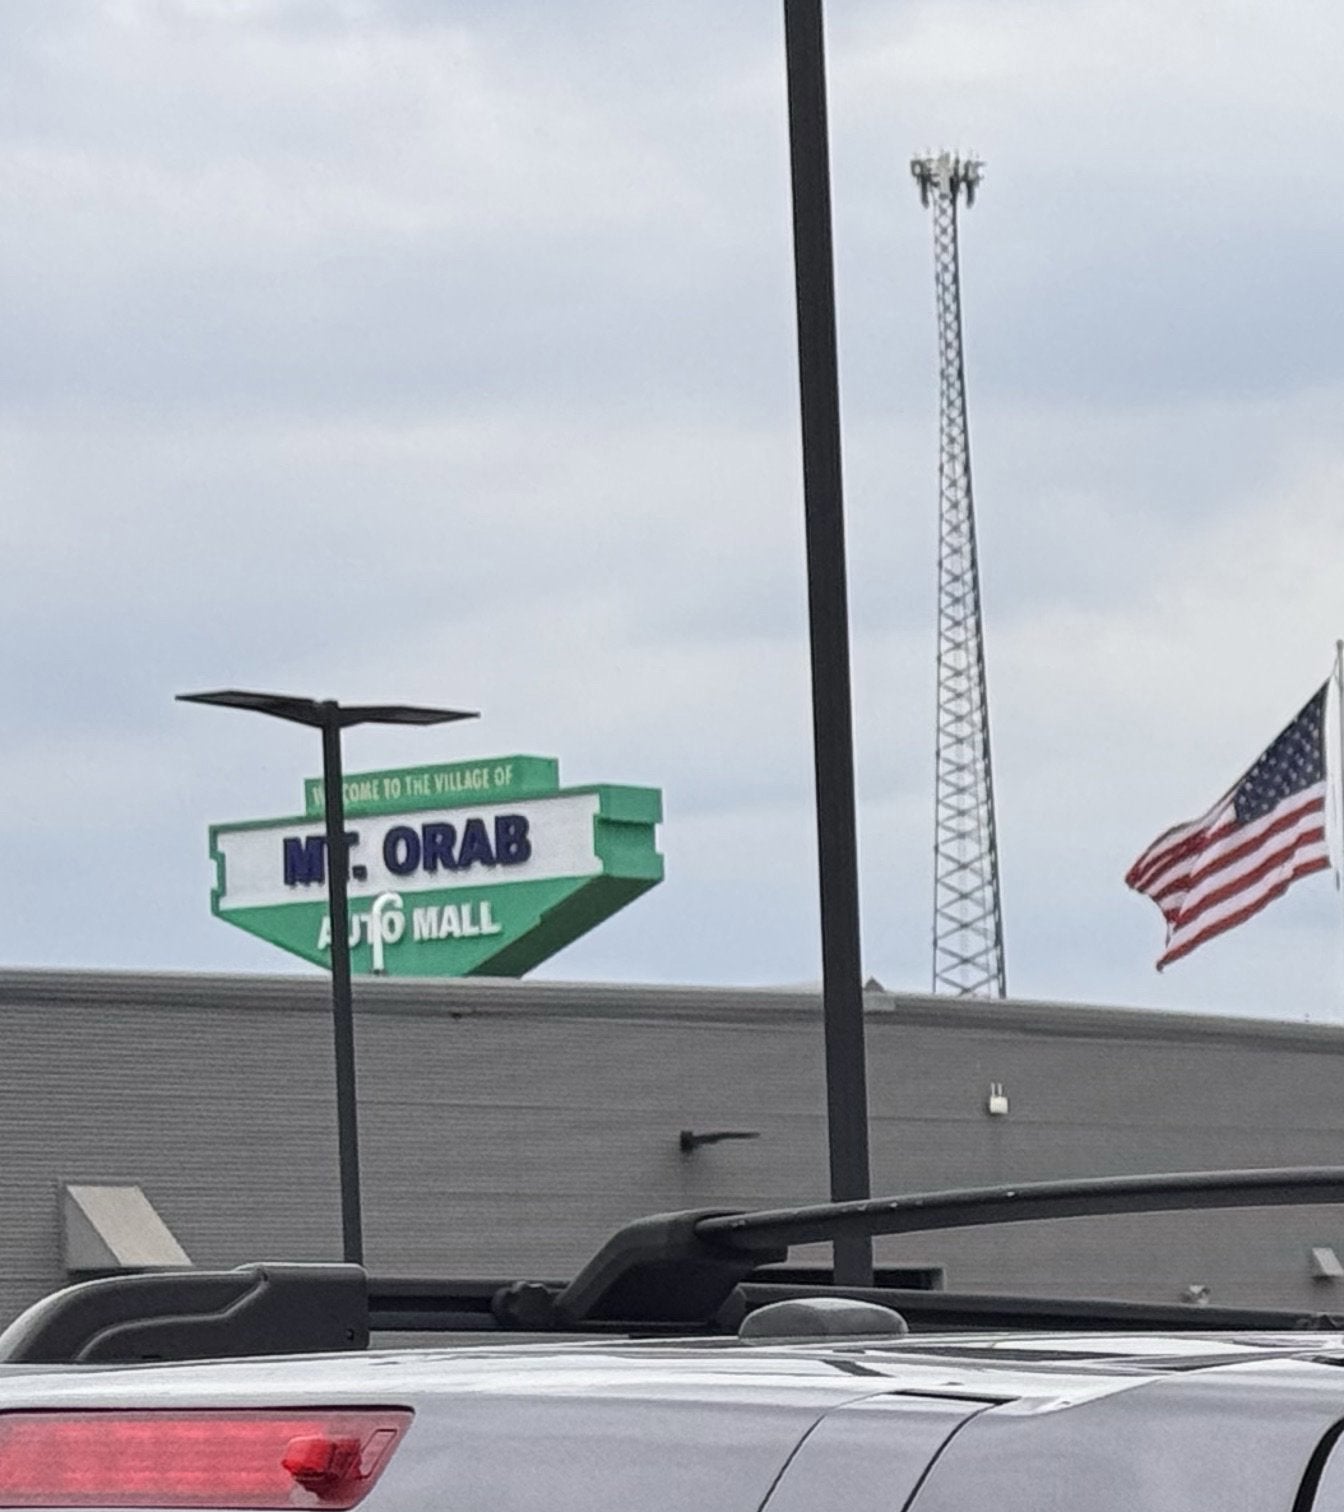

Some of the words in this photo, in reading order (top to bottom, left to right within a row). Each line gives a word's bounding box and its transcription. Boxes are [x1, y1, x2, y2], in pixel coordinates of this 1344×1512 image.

[312, 778, 379, 806] WCOME
[383, 777, 400, 800] TO
[405, 774, 430, 796] THE
[434, 767, 490, 794] VILLAGE
[494, 765, 513, 786] OF
[382, 814, 532, 877] ORAB
[412, 901, 502, 941] MALL
